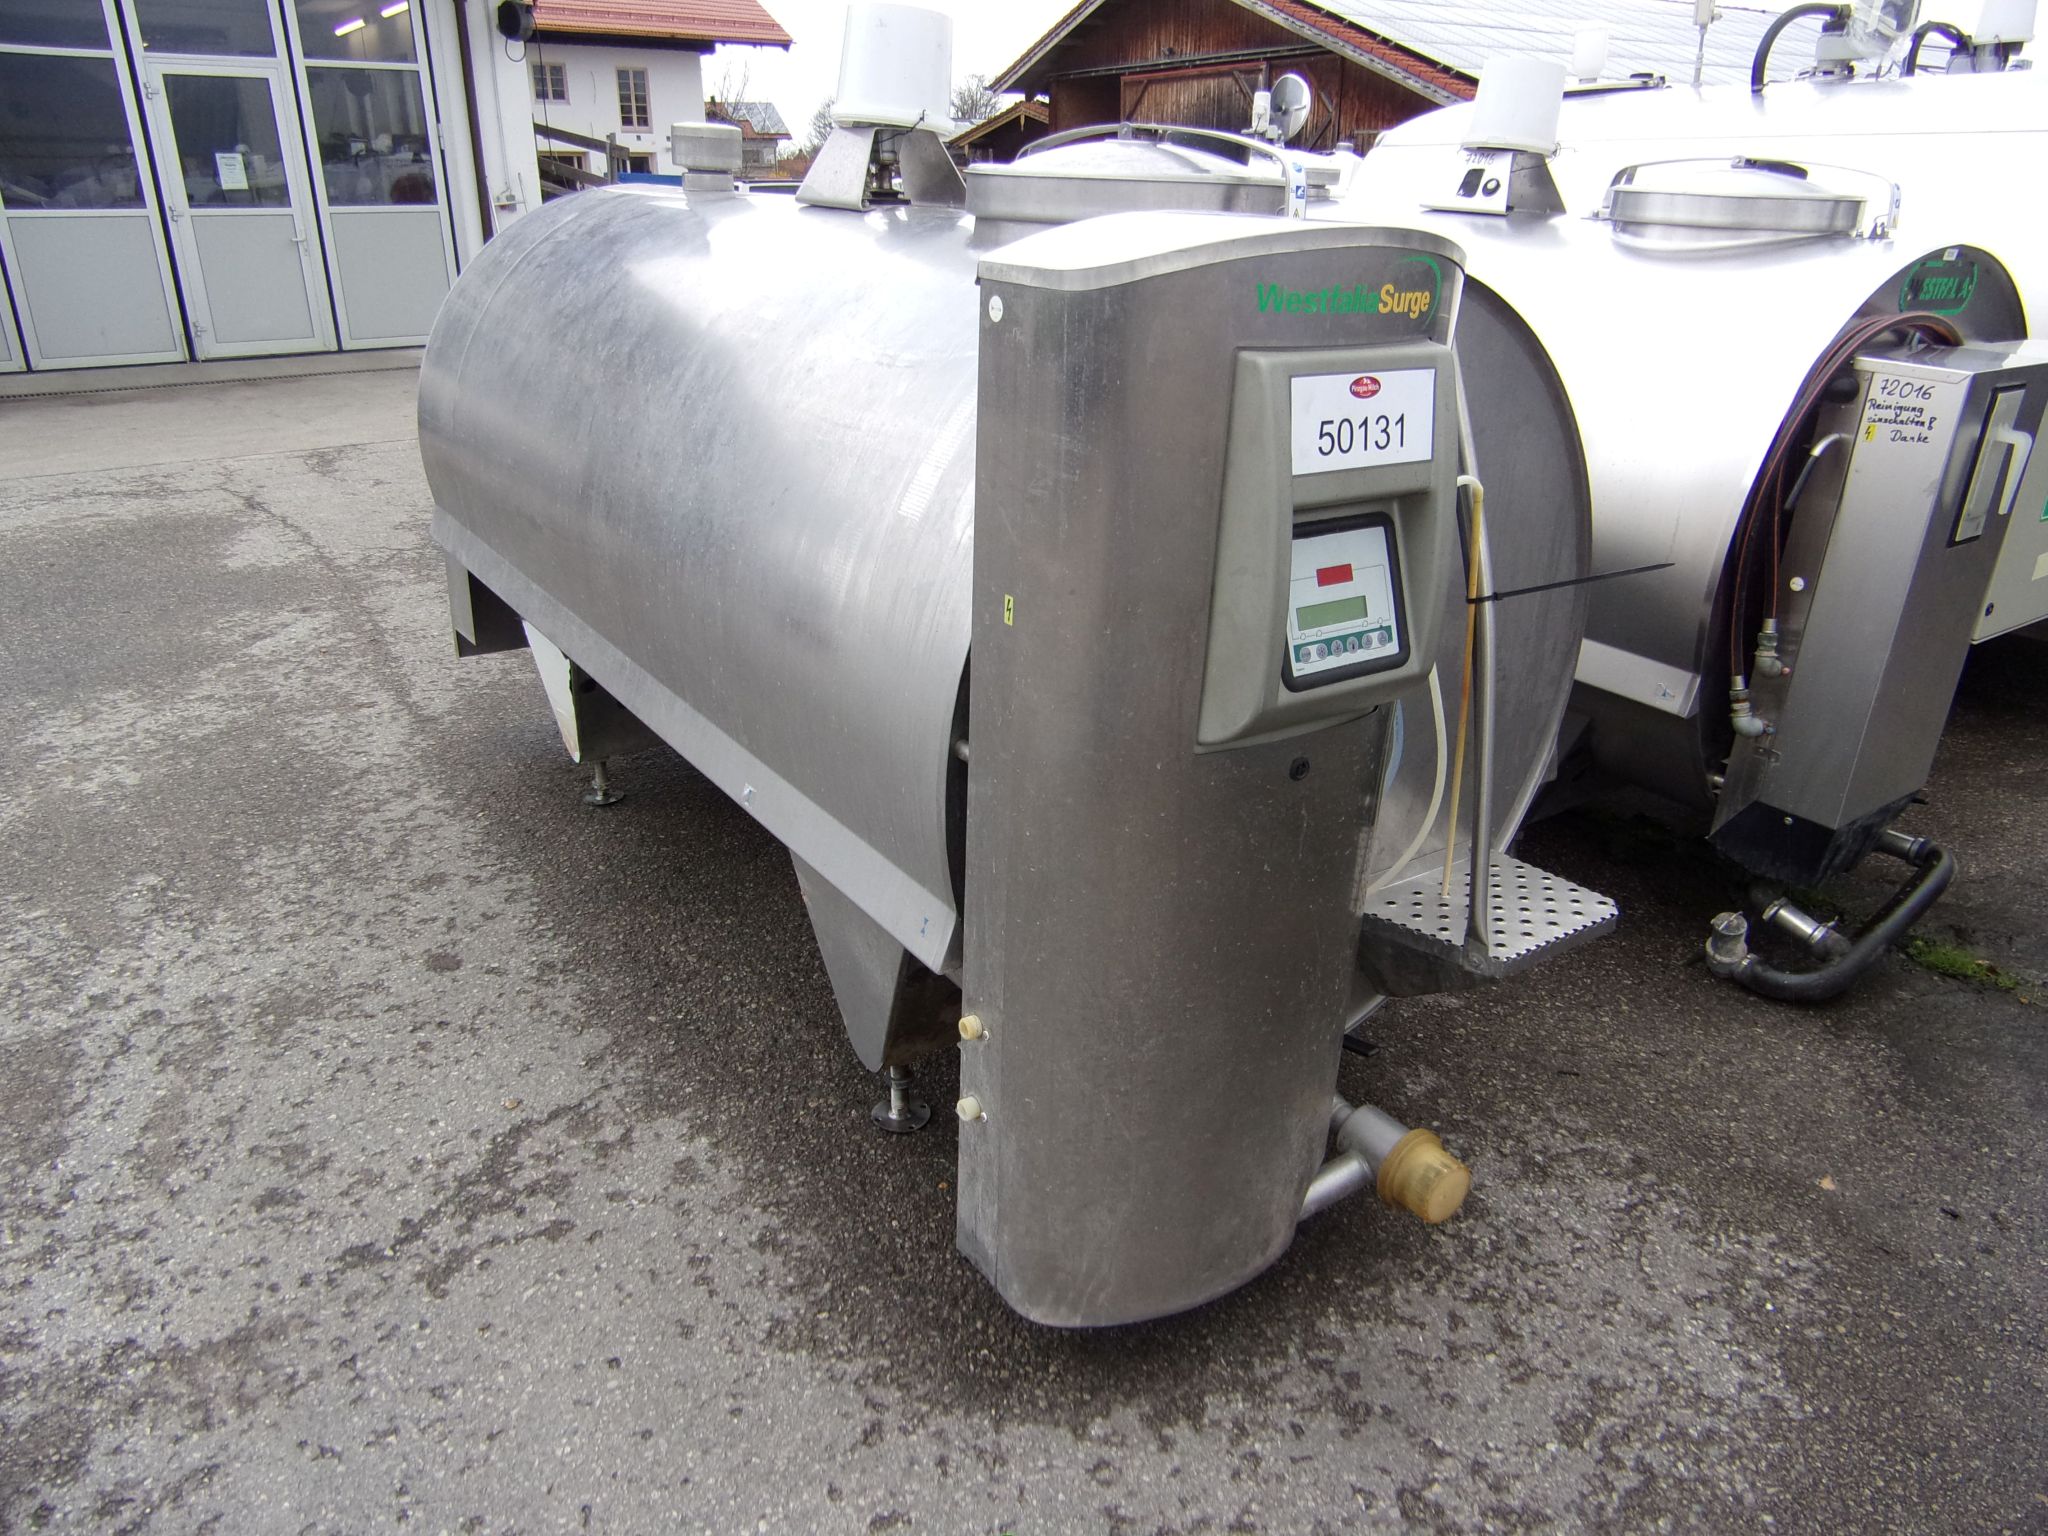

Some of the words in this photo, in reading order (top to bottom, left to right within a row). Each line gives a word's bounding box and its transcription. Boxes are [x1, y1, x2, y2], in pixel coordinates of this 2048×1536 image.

[1880, 379, 1936, 400] 72016
[1868, 399, 1924, 418] Reinigung
[1317, 412, 1406, 457] 50131
[1890, 429, 1930, 444] Danke
